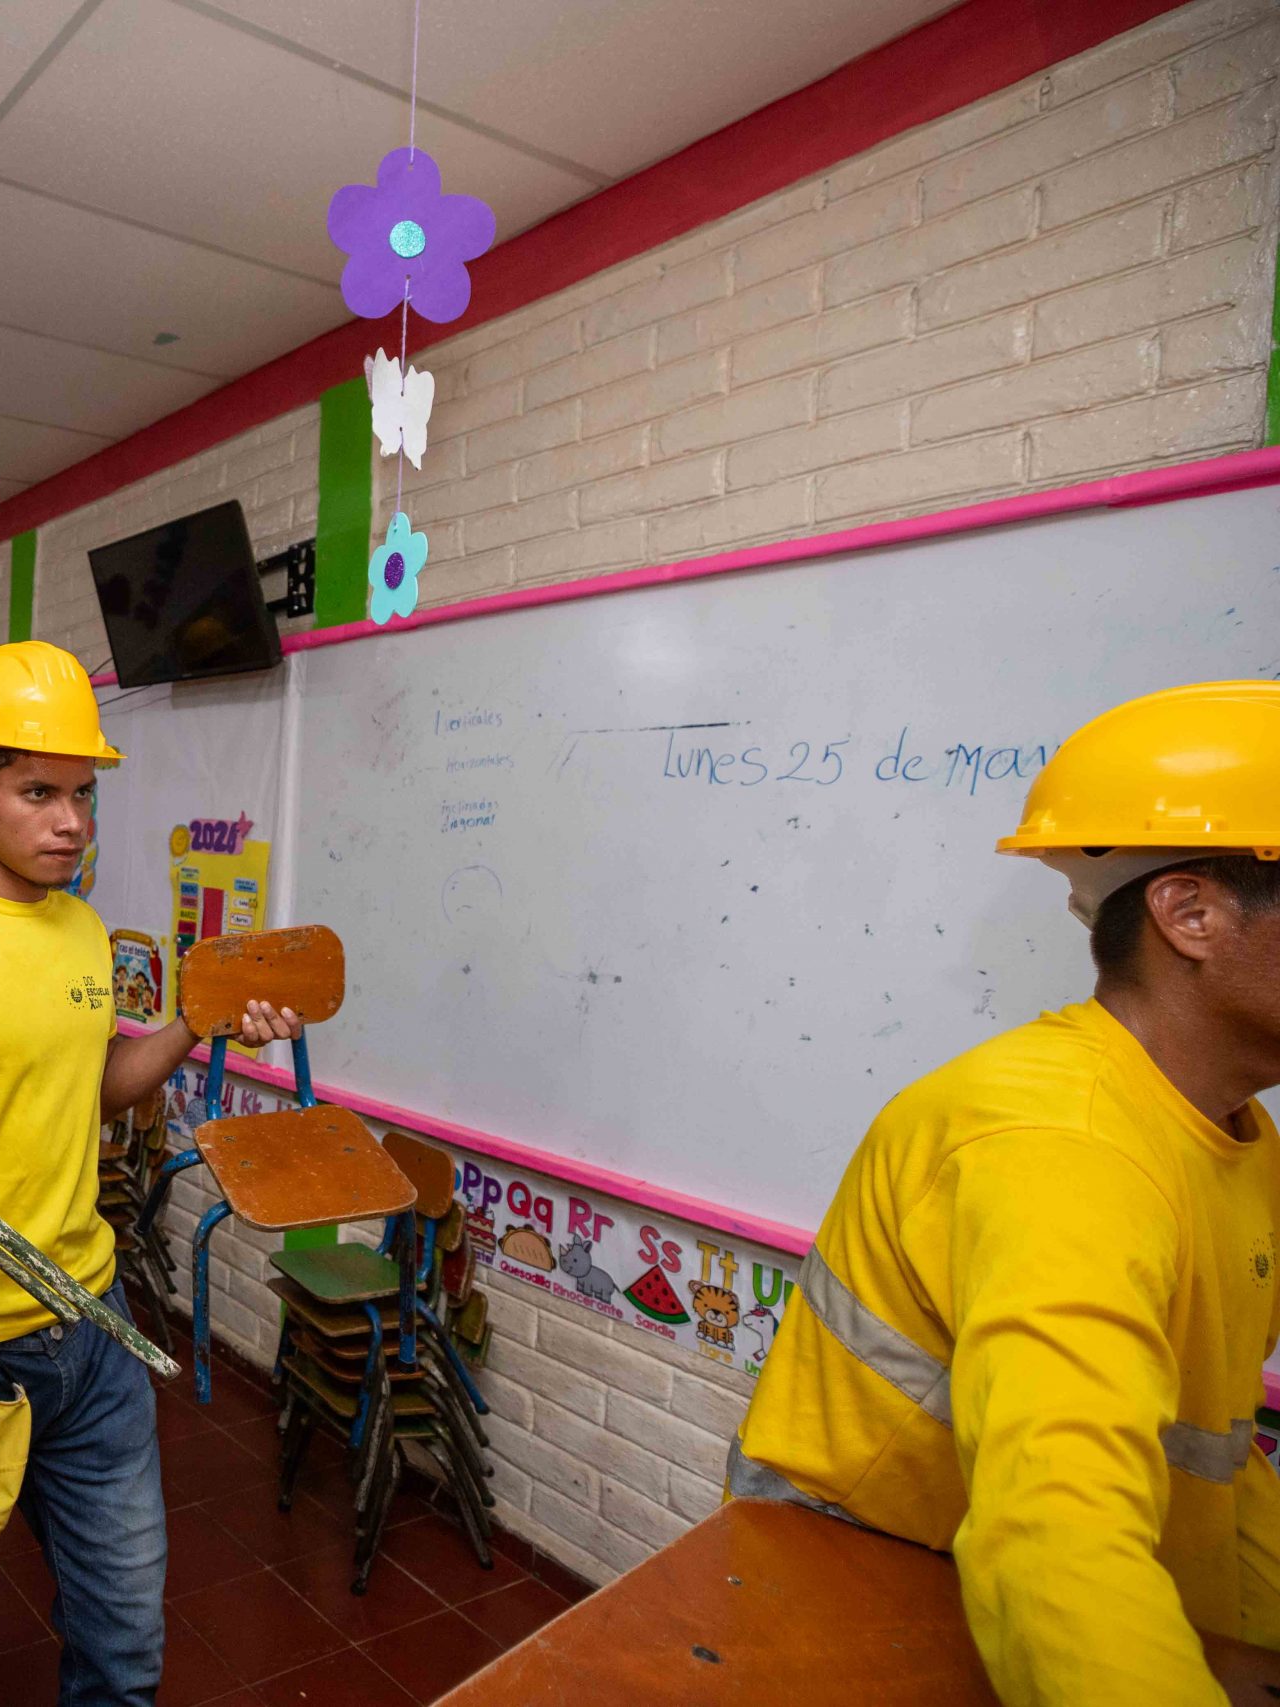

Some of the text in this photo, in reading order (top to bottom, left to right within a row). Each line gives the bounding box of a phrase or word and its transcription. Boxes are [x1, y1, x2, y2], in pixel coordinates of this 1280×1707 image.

[664, 731, 768, 786] Lunes
[776, 741, 850, 785] 25
[875, 726, 928, 781] de
[462, 1161, 503, 1211] Pp
[507, 1181, 553, 1234] Qq
[568, 1196, 614, 1243] Rr
[638, 1225, 682, 1273] Ss
[697, 1240, 739, 1291] Tt
[500, 1260, 551, 1289] Quesadilla
[553, 1283, 624, 1319] Rinoceronte
[697, 1341, 734, 1365] Tigre
